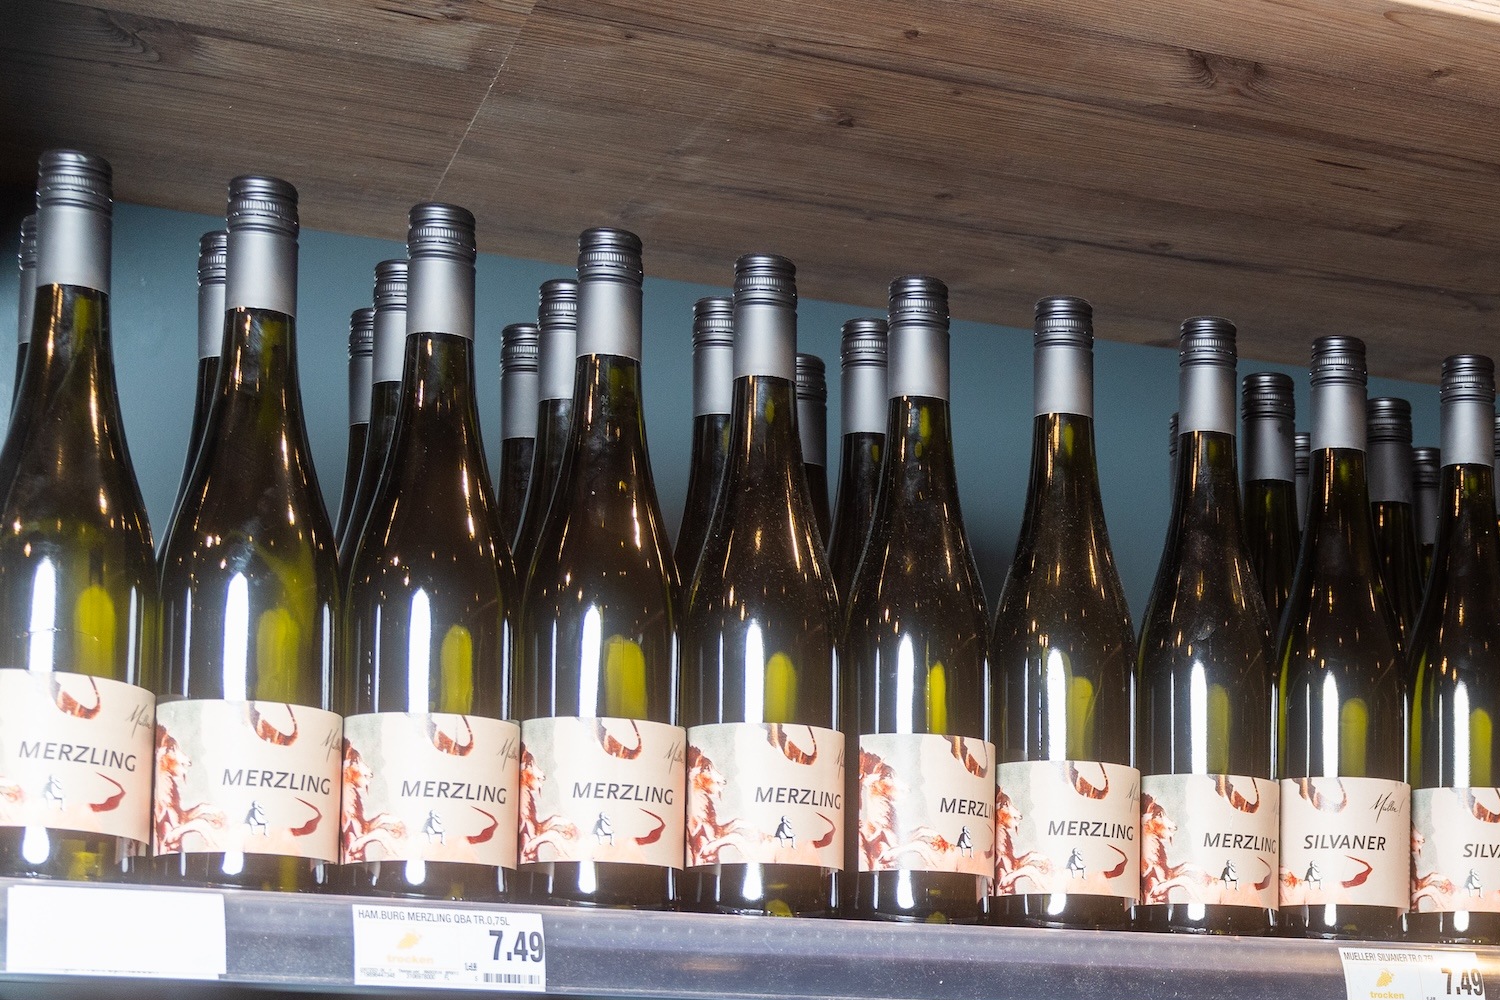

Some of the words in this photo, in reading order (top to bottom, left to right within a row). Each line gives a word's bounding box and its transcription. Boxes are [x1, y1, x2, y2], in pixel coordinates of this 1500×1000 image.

[18, 740, 137, 773] MERZLING
[222, 768, 331, 796] MERZLING
[401, 780, 507, 805] MERZLING
[572, 781, 674, 806] MERZLING
[754, 786, 842, 810] MERZLING
[1047, 820, 1134, 842] MERZLING
[1203, 832, 1277, 854] MERZLING
[1303, 834, 1387, 851] SILVANER
[358, 909, 405, 921] HAM.BURG
[407, 912, 452, 923] MERZLING
[454, 914, 472, 924] QBA
[489, 929, 544, 963] 7.49
[1377, 952, 1408, 962] SILVANER
[1441, 968, 1484, 996] 7.49
[1369, 991, 1405, 999] trocken
